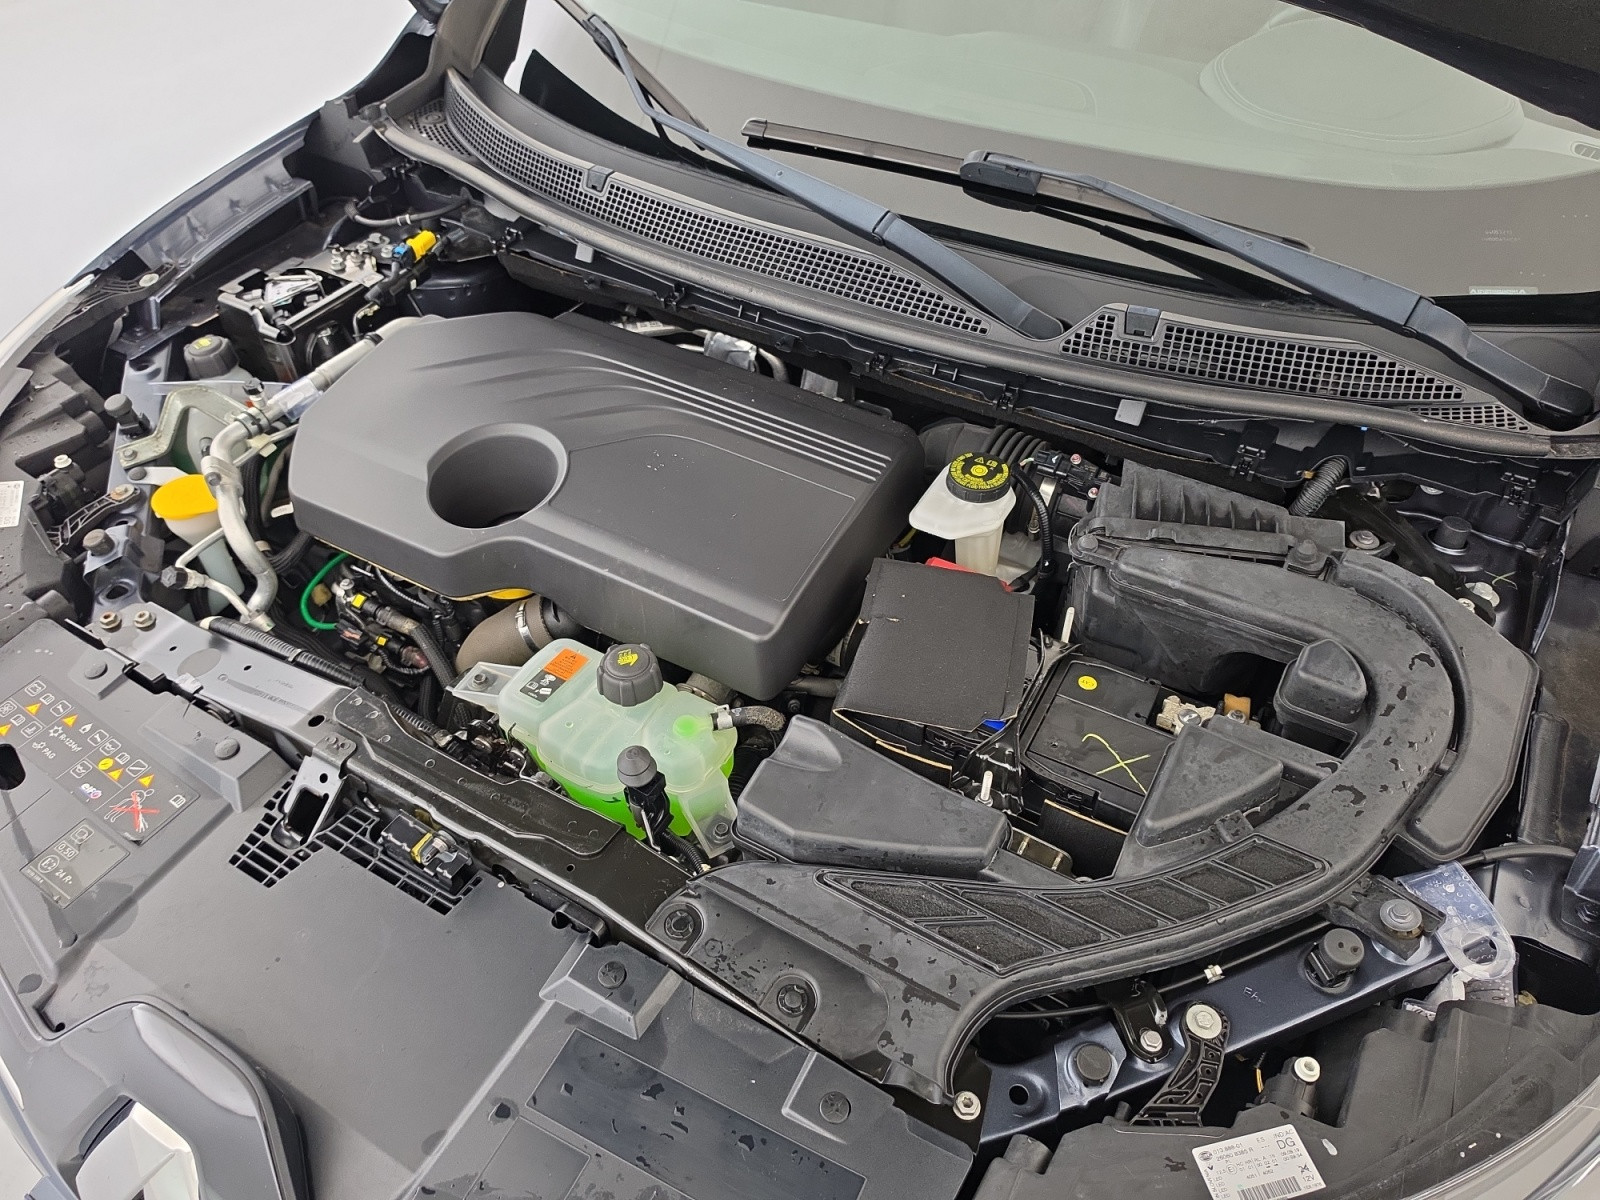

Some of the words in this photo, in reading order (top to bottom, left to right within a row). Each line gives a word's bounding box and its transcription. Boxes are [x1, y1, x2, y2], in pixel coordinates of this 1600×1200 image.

[43, 747, 57, 760] PAG
[58, 843, 75, 857] 0,50
[55, 868, 65, 880] 24
[1276, 1137, 1296, 1150] DG
